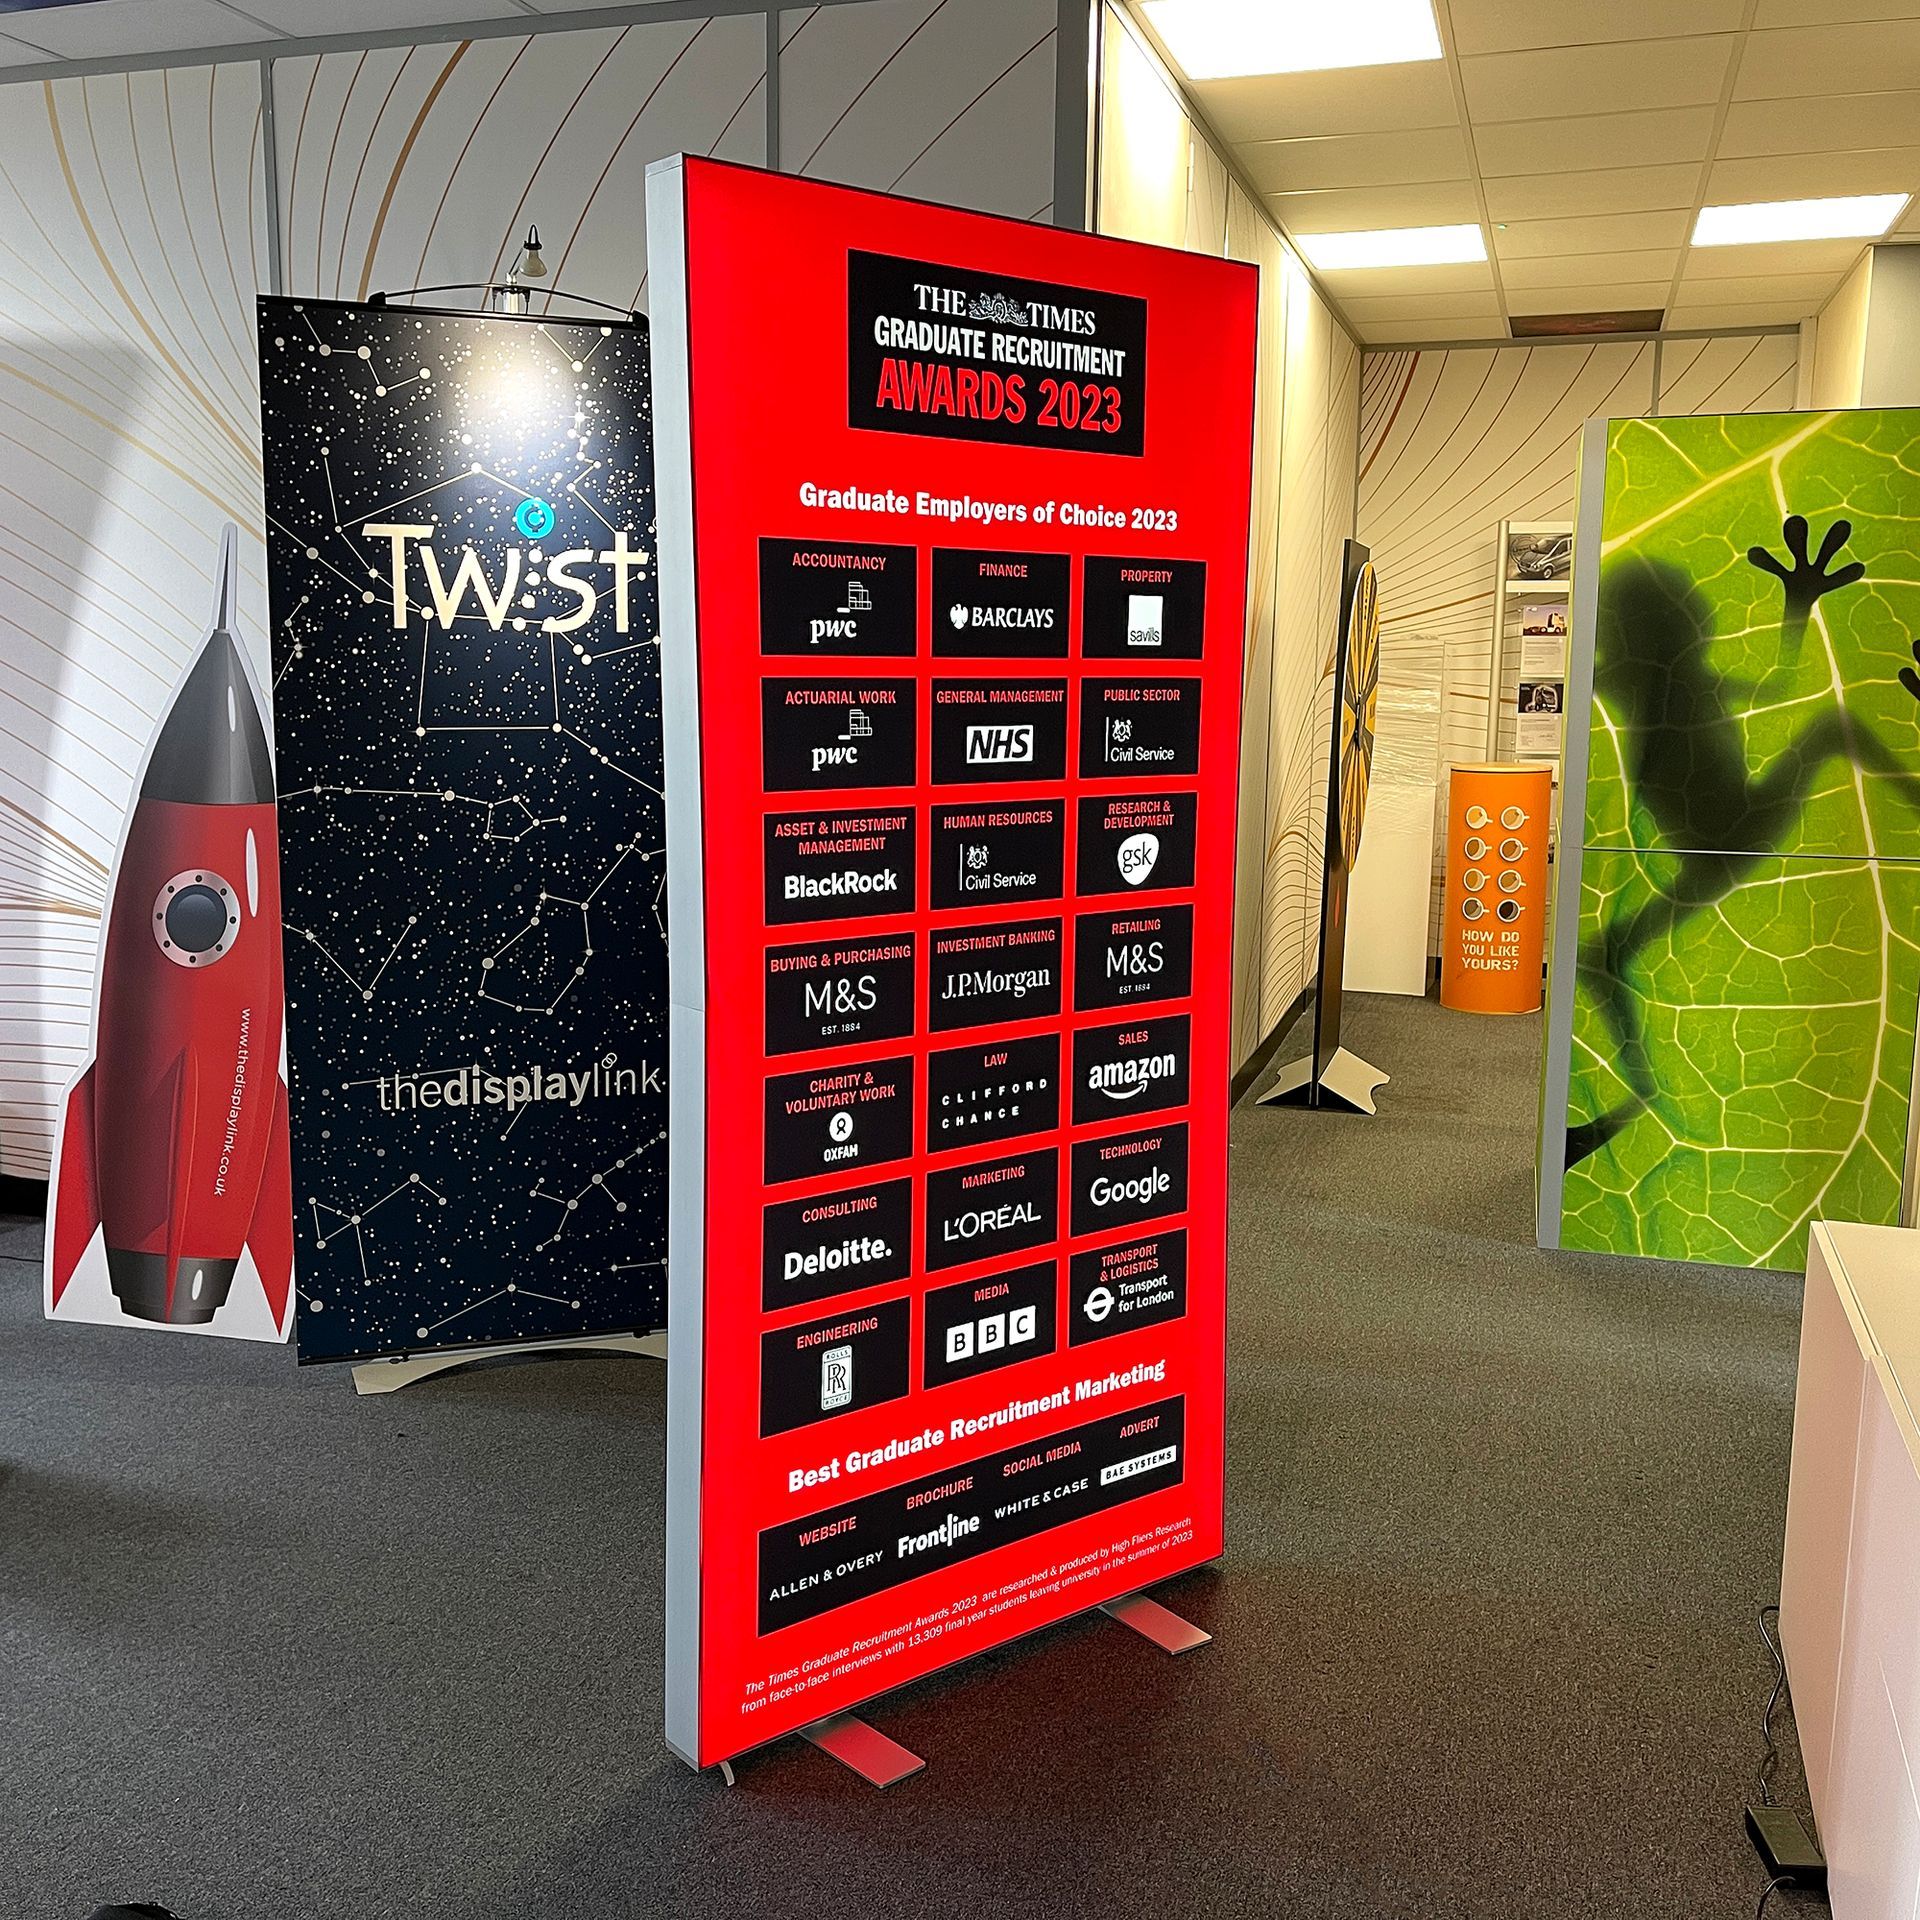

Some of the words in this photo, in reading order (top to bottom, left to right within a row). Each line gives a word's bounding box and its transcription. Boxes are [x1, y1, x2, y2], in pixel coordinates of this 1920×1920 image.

[914, 284, 967, 316] THE
[1026, 302, 1095, 335] TIMES
[874, 315, 986, 360] GRADUATE
[992, 336, 1125, 377] RECRUITMENT
[877, 358, 1026, 423] AWARDS
[1038, 379, 1121, 433] 2023
[800, 482, 909, 513] Graduate
[917, 492, 1026, 524] Employers
[1033, 501, 1055, 524] of
[1060, 504, 1126, 529] Choice
[1131, 508, 1177, 532] 2023
[792, 552, 886, 570] ACCOUNTANCY
[979, 563, 1028, 578] FINANCE
[1121, 570, 1173, 582] PROPERTY
[971, 606, 1053, 629] BARCLAYS
[810, 618, 857, 643] pwc
[1130, 628, 1160, 643] savills
[785, 690, 857, 705] ACTUARIAL
[859, 690, 896, 704] WORK
[936, 690, 988, 703] GENERAL
[990, 690, 1064, 702] MANAGEMENT
[1104, 690, 1137, 701] PUBLIC
[1139, 689, 1180, 701] SECTOR
[969, 729, 1029, 759] NHS
[1110, 747, 1133, 762] Civil
[1136, 747, 1174, 761] Service
[812, 746, 857, 771] pwc
[1109, 801, 1159, 815] RESEARCH
[1163, 800, 1171, 813] &
[775, 821, 815, 837] ASSET
[818, 820, 828, 835] &
[832, 817, 906, 834] INVESTMENT
[944, 814, 985, 829] HUMAN
[988, 811, 1053, 827] RESOURCES
[1104, 814, 1174, 829] DEVELOPMENT
[799, 837, 885, 855] MANAGEMENT
[1122, 841, 1152, 872] gsk
[784, 868, 897, 899] BlackRock
[965, 874, 990, 890] Civil
[993, 871, 1036, 888] Service
[1112, 919, 1161, 935] RETAILING
[1462, 929, 1494, 942] HOW
[1502, 932, 1519, 942] DO
[937, 934, 1005, 953] INVESTMENT
[1008, 930, 1055, 947] BANKING
[1462, 943, 1484, 955] YOU
[1490, 946, 1519, 956] LIKE
[770, 955, 817, 973] BUYING
[821, 954, 831, 967] &
[834, 945, 911, 965] PURCHASING
[1106, 942, 1164, 978] M&S
[1462, 957, 1518, 970] YOURS?
[804, 975, 877, 1018] M&S
[1119, 1031, 1148, 1045] SALES
[984, 1053, 1007, 1067] LAW
[1088, 1053, 1175, 1090] amazon
[376, 1052, 661, 1111] thedisplaylink
[810, 1074, 860, 1093] CHARITY
[864, 1071, 873, 1085] &
[942, 1078, 1048, 1106] CLIFFORD
[214, 1008, 250, 1197] www.thedisplaylink.co.uk
[785, 1091, 856, 1114] VOLUNTARY
[859, 1084, 896, 1102] WORK
[942, 1106, 1020, 1129] CHANCE
[824, 1144, 858, 1162] OXFAM
[1100, 1138, 1163, 1160] TECHNOLOGY
[962, 1165, 1025, 1189] MARKETING
[1090, 1166, 1170, 1207] Google
[802, 1197, 877, 1223] CONSULTING
[1101, 1244, 1158, 1266] TRANSPORT
[1100, 1271, 1108, 1281] &
[1110, 1258, 1158, 1279] LOGISTICS
[974, 1283, 1009, 1303] MEDIA
[1118, 1275, 1167, 1296] Transport
[1118, 1299, 1134, 1314] for
[1137, 1289, 1174, 1308] London
[797, 1317, 878, 1350] ENGINEERING
[950, 1310, 1032, 1357] BBC
[789, 1459, 840, 1493] Best
[846, 1430, 944, 1472] Graduate
[950, 1392, 1070, 1440] Recruitment
[1075, 1359, 1165, 1401] Marketing
[1120, 1416, 1159, 1439] ADVERT
[1003, 1454, 1043, 1477] SOCIAL
[1046, 1441, 1081, 1463] MEDIA
[1106, 1467, 1124, 1481] BAE
[1127, 1449, 1173, 1472] SYSTEMS
[906, 1477, 974, 1510] BROCHURE
[995, 1495, 1039, 1518] WHITE
[1043, 1491, 1052, 1502] &
[1054, 1479, 1088, 1499] CASE
[799, 1516, 857, 1547] WEBSITE
[899, 1513, 979, 1559] Frontline
[769, 1575, 819, 1601] ALLEN
[823, 1568, 833, 1581] &
[836, 1551, 883, 1578] OVERY
[746, 1682, 764, 1695] The
[768, 1668, 798, 1686] Times
[802, 1648, 849, 1673] Graduate
[852, 1623, 912, 1652] Recruitment
[914, 1608, 949, 1629] Awards
[952, 1596, 977, 1614] 2023
[982, 1589, 997, 1602] are
[1000, 1569, 1048, 1595] researched
[1050, 1566, 1057, 1575] &
[1059, 1551, 1098, 1574] produced
[1100, 1547, 1109, 1557] by
[1112, 1539, 1130, 1553] High
[1132, 1531, 1153, 1546] Fliers
[1156, 1518, 1191, 1536] Research
[742, 1696, 766, 1714] from
[769, 1672, 829, 1703] face-to-face
[832, 1650, 882, 1678] interviews
[885, 1642, 905, 1656] with
[945, 1616, 965, 1633] final
[967, 1611, 987, 1625] year
[989, 1593, 1027, 1614] students
[1029, 1581, 1060, 1600] leaving
[1062, 1564, 1100, 1586] university
[1103, 1561, 1111, 1571] in
[1113, 1556, 1126, 1568] the
[1128, 1545, 1160, 1562] summer
[1162, 1538, 1170, 1550] of
[1172, 1530, 1193, 1545] 2023
